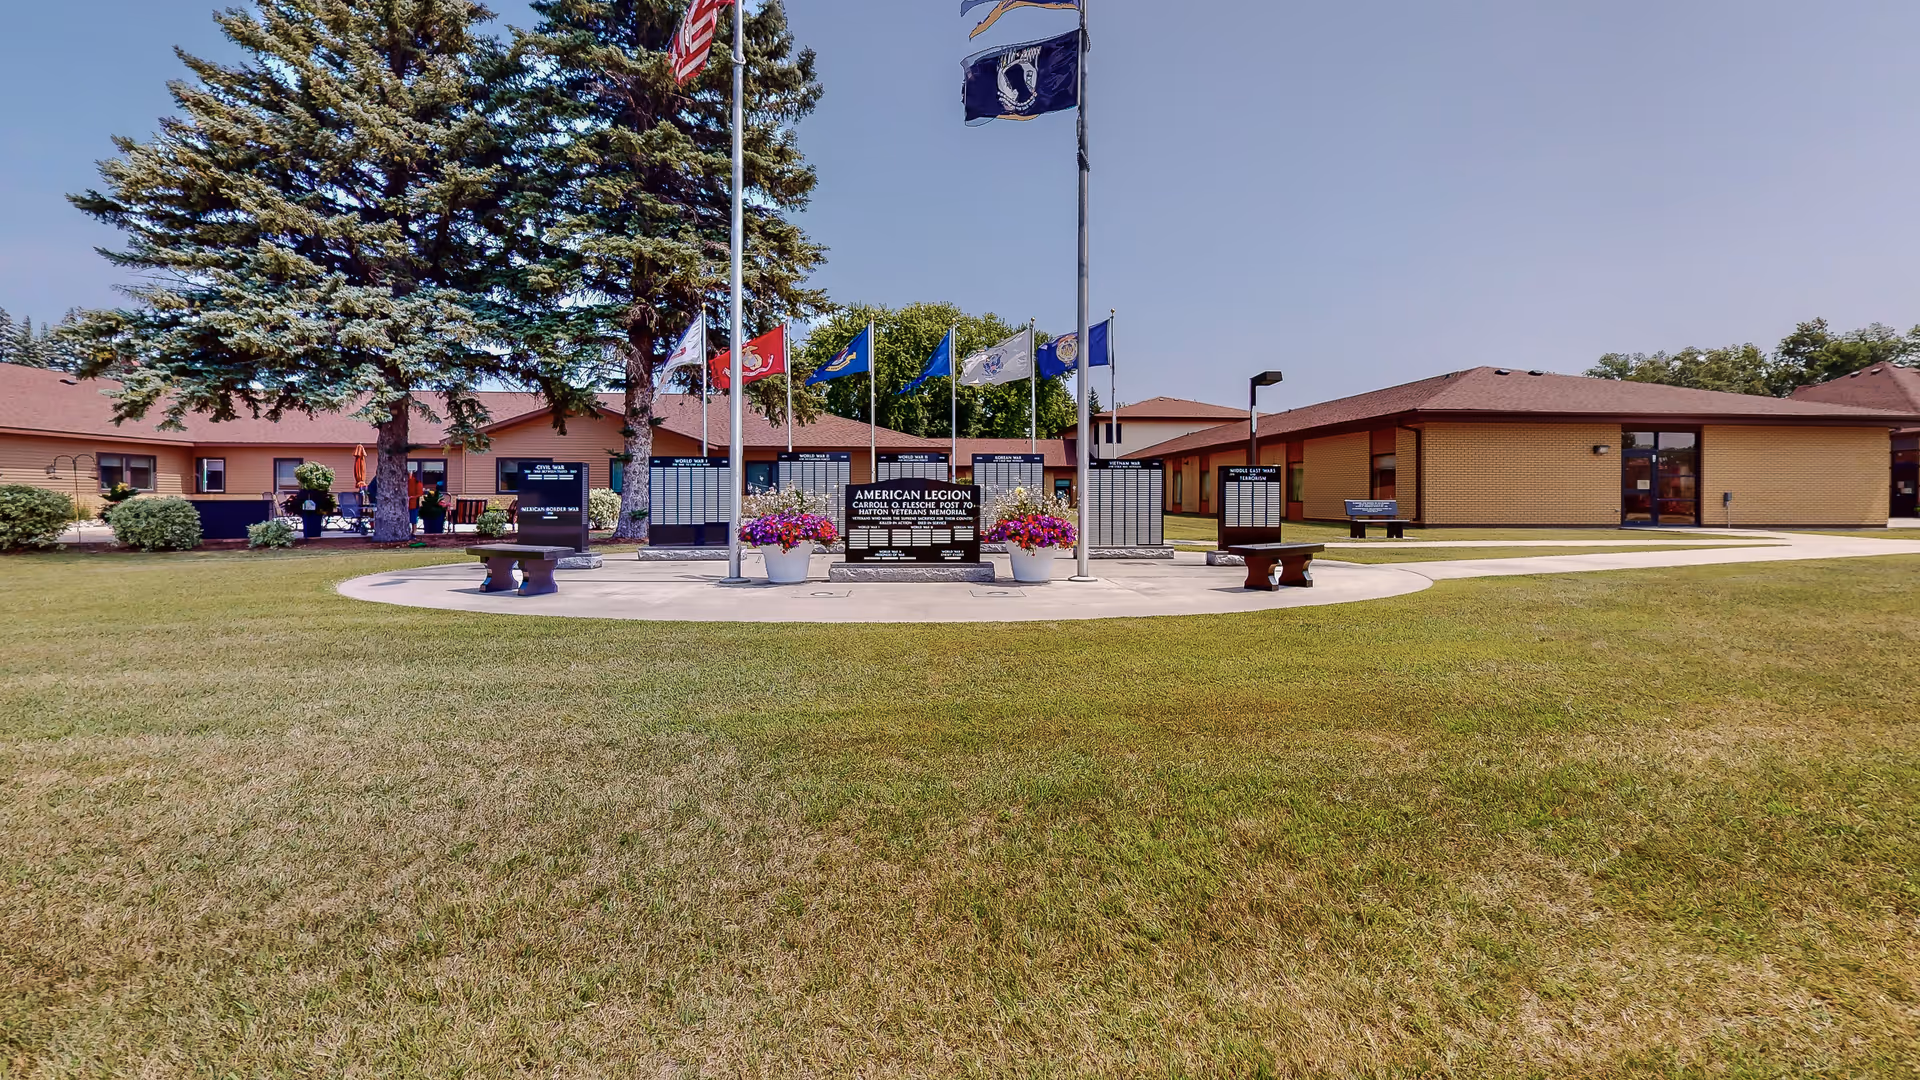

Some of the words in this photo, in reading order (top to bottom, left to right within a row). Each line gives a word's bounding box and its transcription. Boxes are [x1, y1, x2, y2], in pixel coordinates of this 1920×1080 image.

[855, 490, 920, 500] AMERICAN
[925, 490, 971, 500] LEGION
[852, 501, 889, 509] CARROLL
[891, 501, 900, 509] O.
[902, 501, 935, 509] FLESCHE
[940, 501, 959, 509] POST
[963, 501, 973, 509] 70
